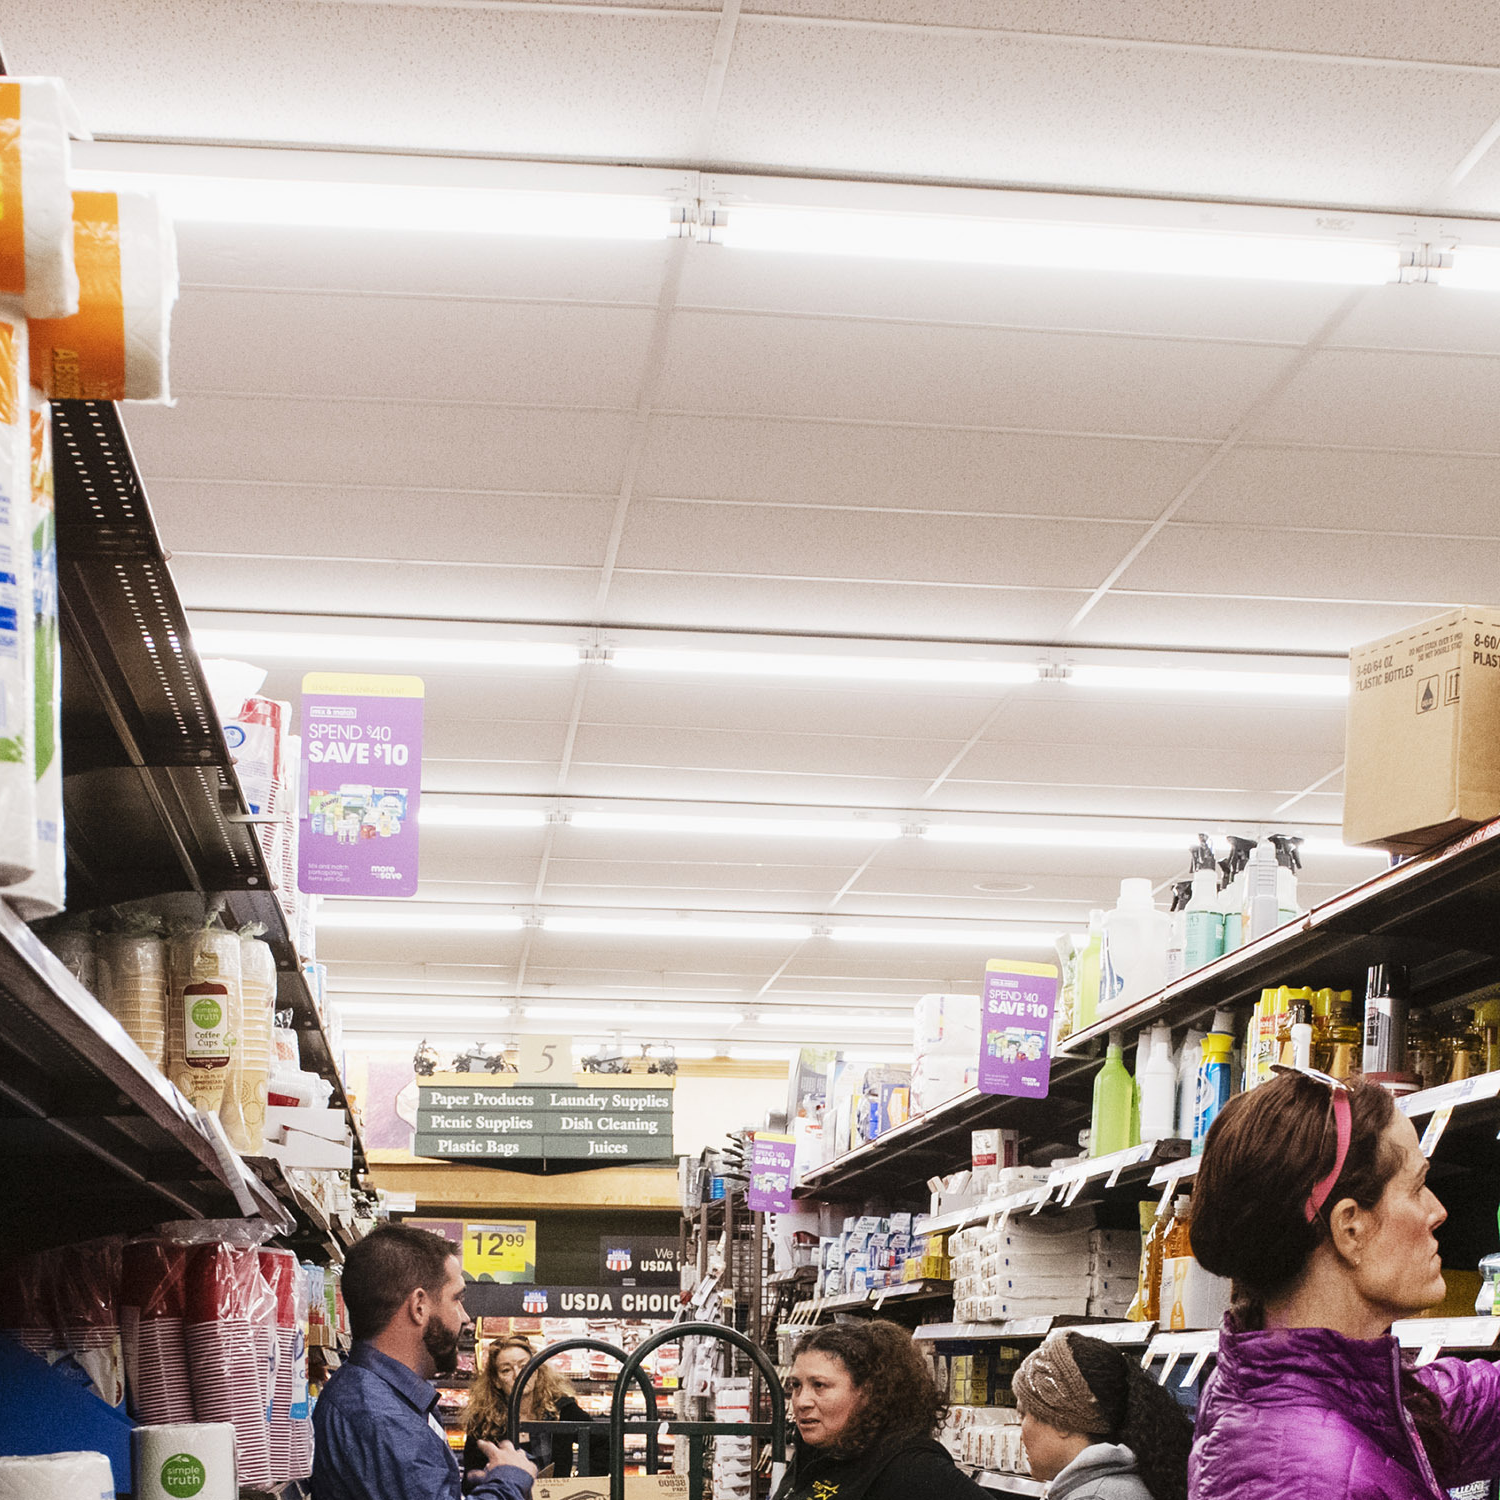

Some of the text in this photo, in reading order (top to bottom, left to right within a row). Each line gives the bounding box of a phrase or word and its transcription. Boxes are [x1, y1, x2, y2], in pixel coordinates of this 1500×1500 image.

[1385, 664, 1414, 684] BOTTLES
[308, 723, 392, 741] SPEND $40
[308, 741, 409, 766] SAVE $10
[371, 865, 396, 873] more
[380, 872, 402, 880] save
[988, 989, 1039, 1003] SPEND $40
[987, 1000, 1048, 1018] SAVE $10
[195, 1013, 219, 1021] truth
[194, 1031, 220, 1040] Coffee
[197, 1039, 218, 1048] Cups
[534, 1044, 558, 1074] 5
[430, 1092, 534, 1109] Paper Products
[549, 1093, 669, 1111] Laundry Supplies
[430, 1115, 533, 1133] Picnic Supplies
[560, 1116, 659, 1134] Dish Cleaning
[437, 1139, 520, 1157] Plastic Bags
[587, 1140, 629, 1155] Juices
[755, 1156, 777, 1166] SAVE
[655, 1248, 674, 1260] We
[640, 1260, 673, 1272] USDA
[559, 1293, 613, 1312] USDA
[166, 1465, 201, 1479] simple
[167, 1473, 201, 1487] truth
